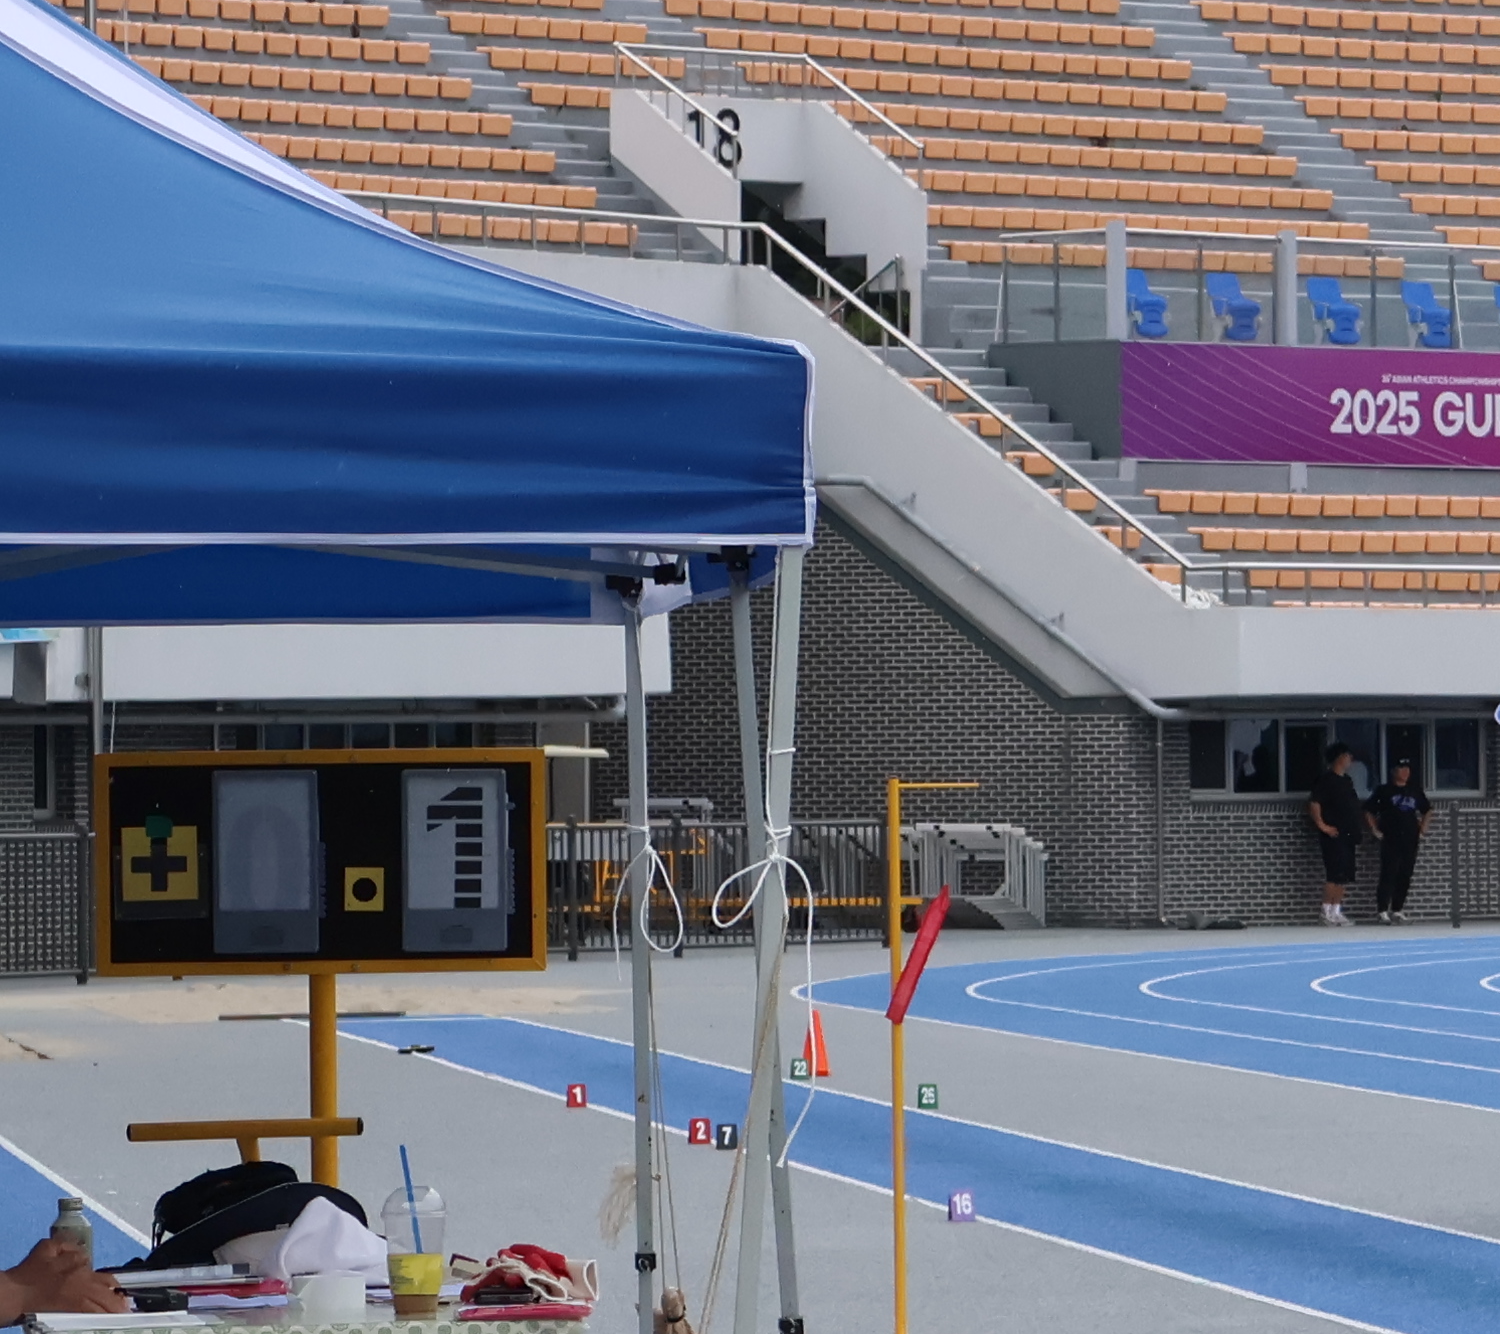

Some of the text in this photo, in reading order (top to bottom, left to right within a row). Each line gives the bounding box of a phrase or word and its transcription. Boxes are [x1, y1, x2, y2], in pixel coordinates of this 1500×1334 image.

[688, 108, 742, 170] 18
[1330, 388, 1421, 436] 2025
[793, 1061, 807, 1076] 22
[572, 1086, 582, 1104] 1
[695, 1121, 707, 1140] 2
[722, 1126, 733, 1146] 7
[952, 1193, 973, 1215] 16
